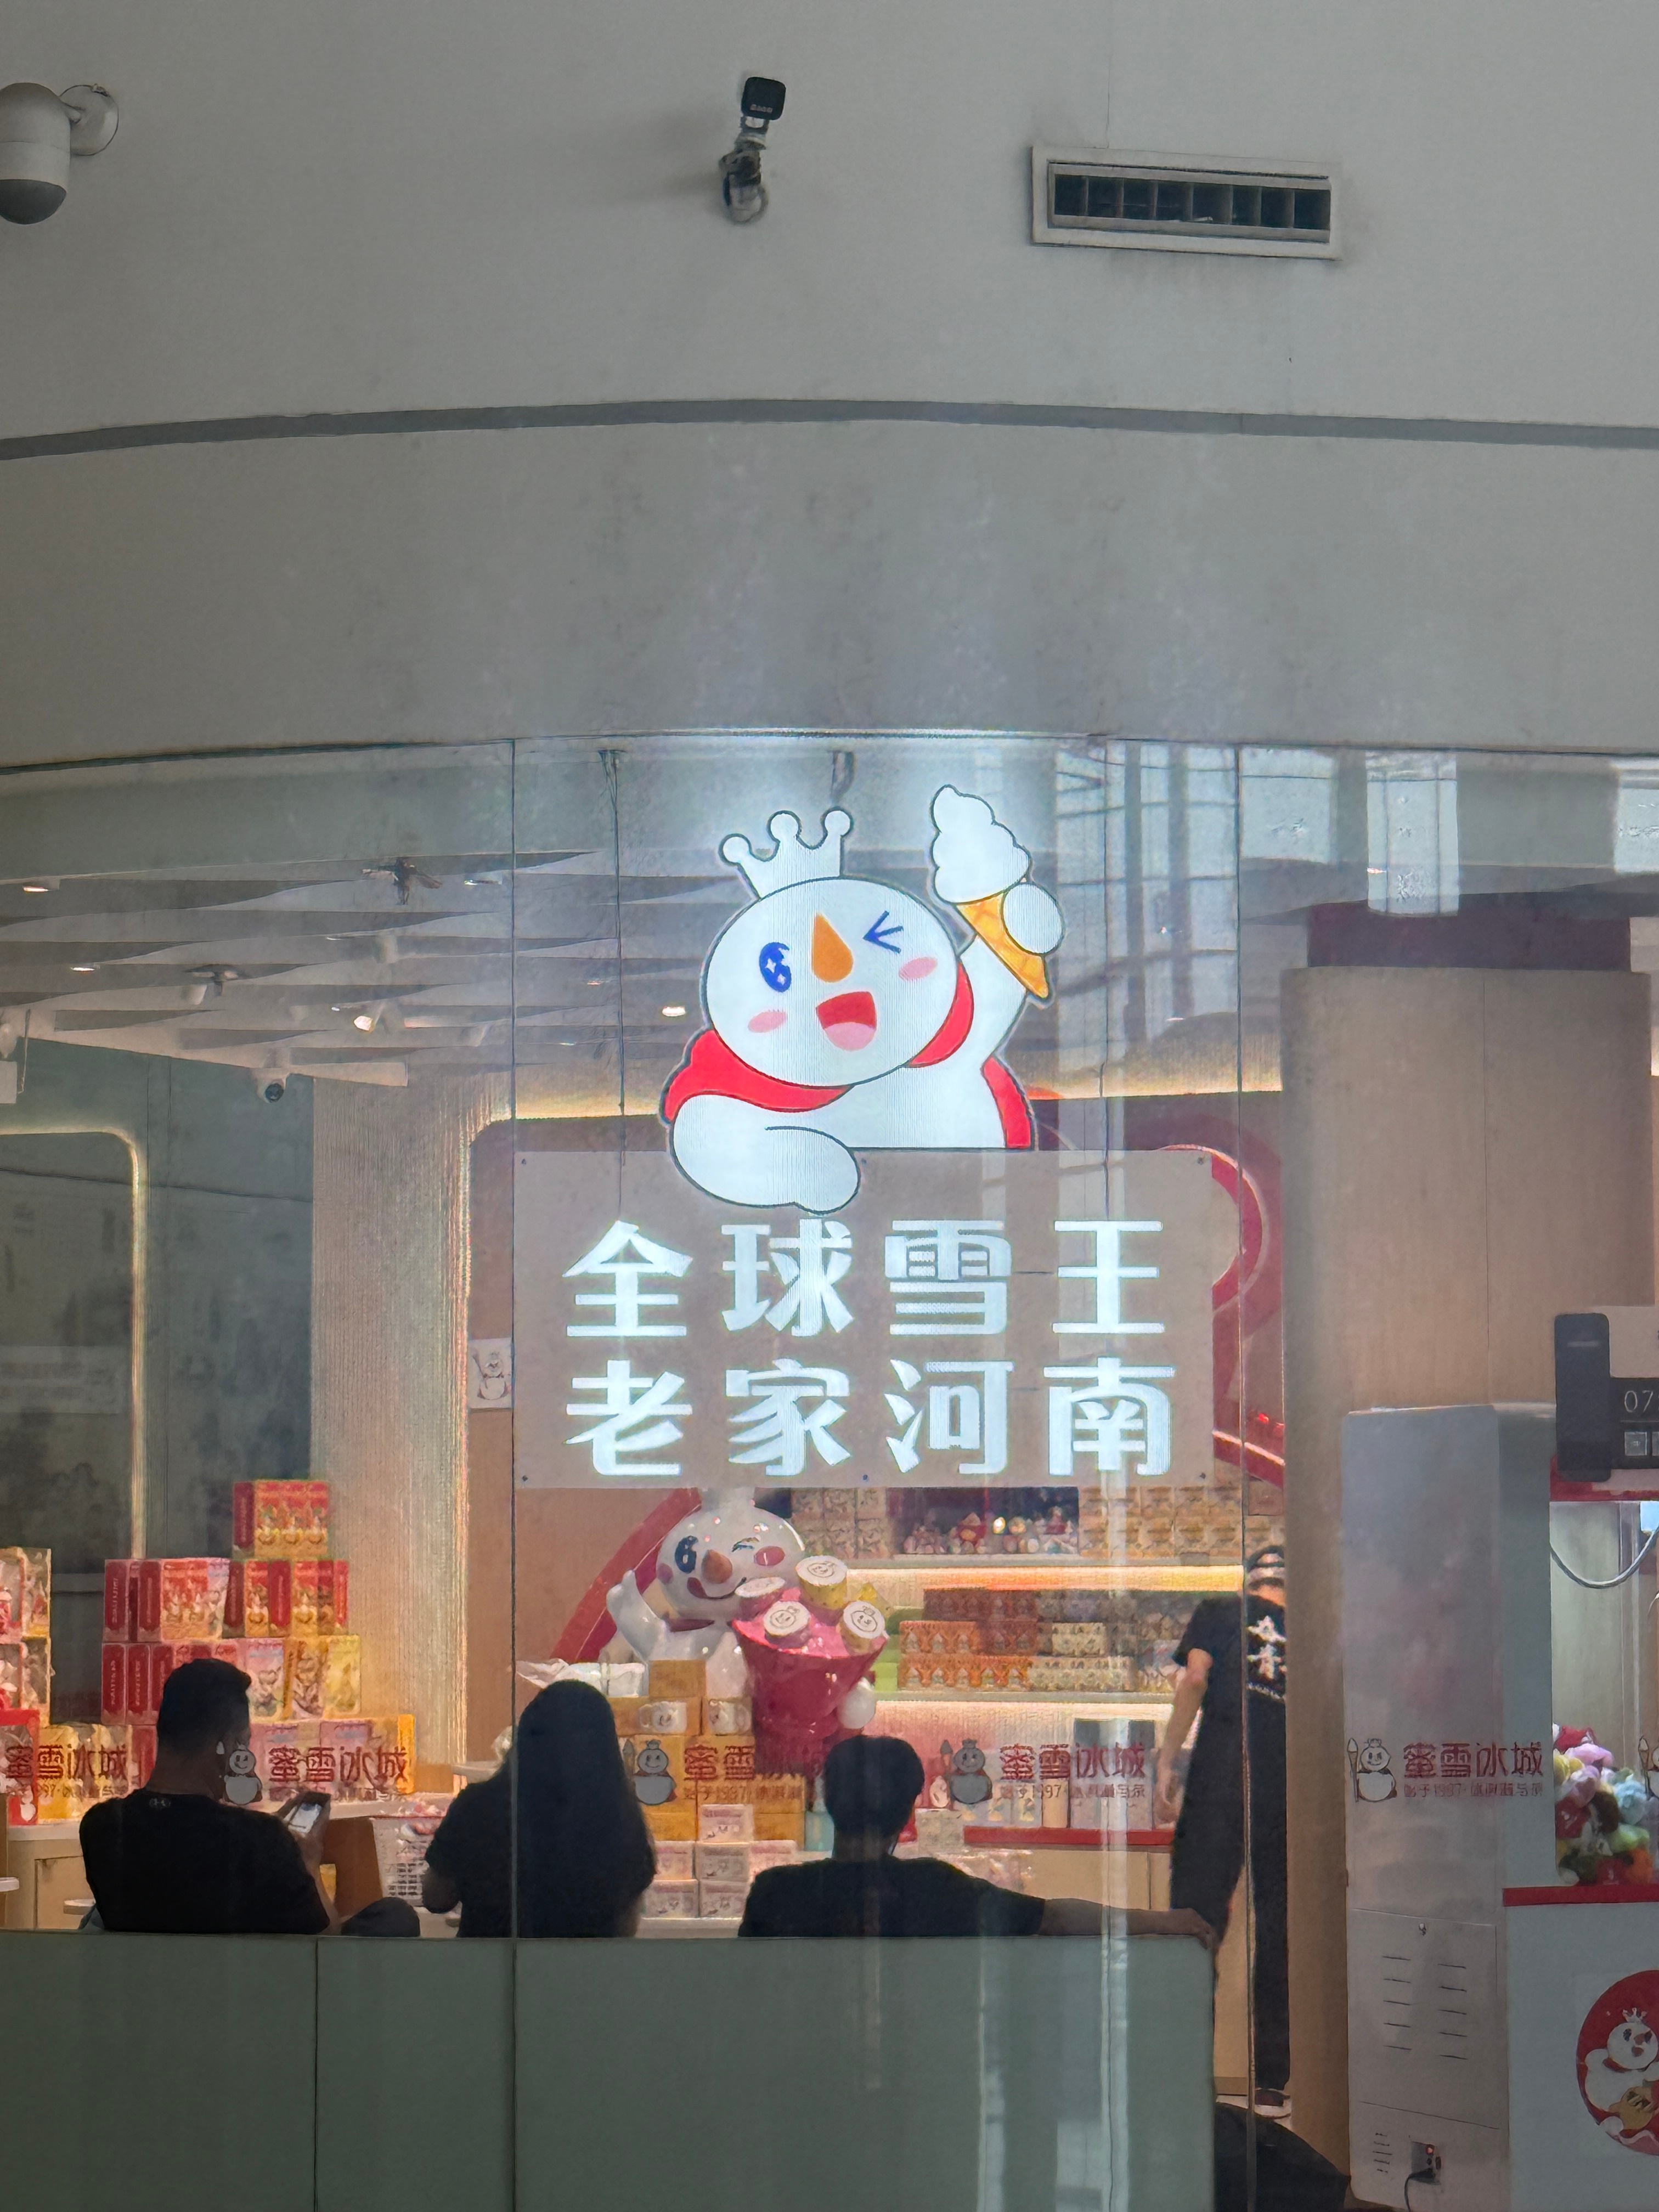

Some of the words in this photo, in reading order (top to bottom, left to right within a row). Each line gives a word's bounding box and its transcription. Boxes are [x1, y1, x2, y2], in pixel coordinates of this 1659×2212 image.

[562, 1217, 1165, 1338] 全球雪王
[564, 1357, 1177, 1477] 老家河南
[5, 1744, 129, 1780] 蜜雪冰城
[268, 1745, 408, 1784] 蜜雪冰城
[1000, 1742, 1146, 1780] 蜜雪冰城
[1403, 1741, 1543, 1778] 蜜雪冰城
